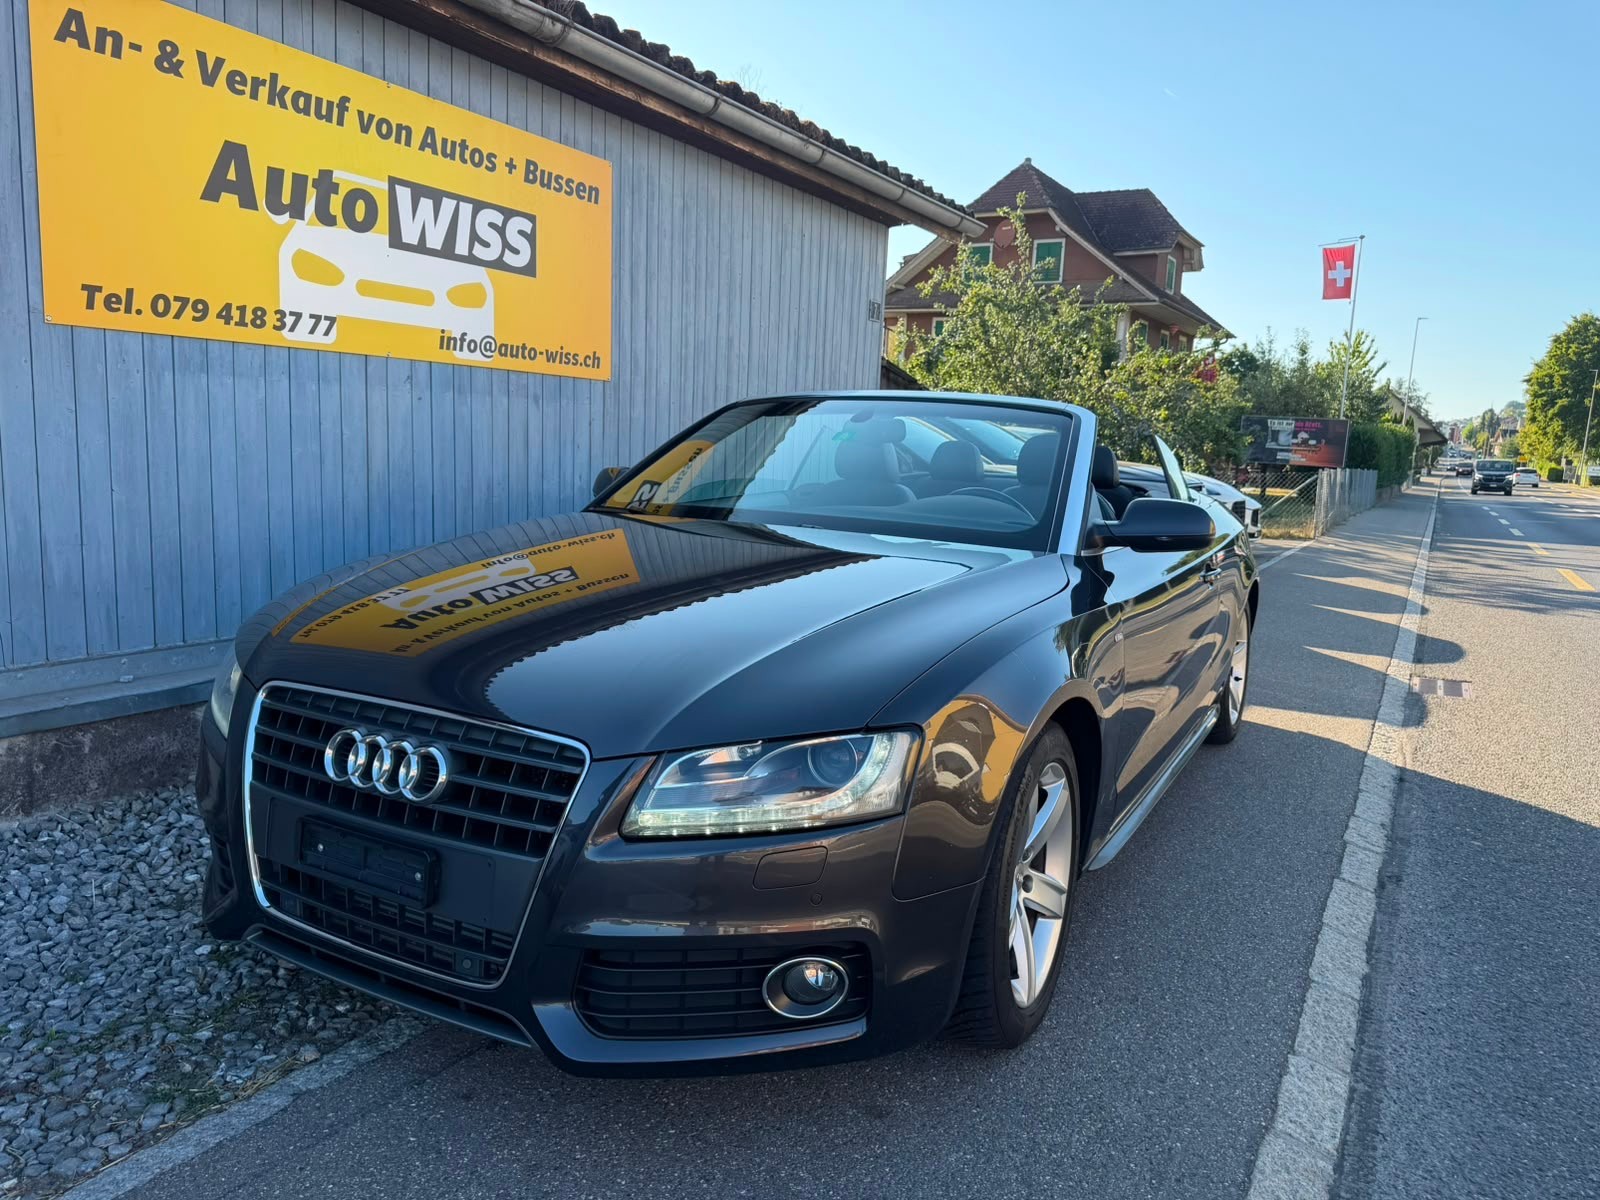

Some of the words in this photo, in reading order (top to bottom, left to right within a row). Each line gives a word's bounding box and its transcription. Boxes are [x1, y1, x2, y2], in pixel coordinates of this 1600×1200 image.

[53, 7, 143, 60] An-
[154, 39, 185, 79] &
[195, 49, 351, 128] Verkauf
[356, 109, 412, 148] von
[418, 126, 498, 173] Autos
[504, 157, 517, 176] +
[523, 158, 600, 205] Bussen
[199, 139, 379, 234] Auto
[394, 183, 534, 268] WISS
[81, 283, 143, 316] Tel.
[150, 293, 210, 323] 079
[216, 302, 267, 330] 418
[272, 309, 303, 333] 37
[307, 313, 337, 337] 77
[438, 328, 602, 370] info@auto-wiss.ch
